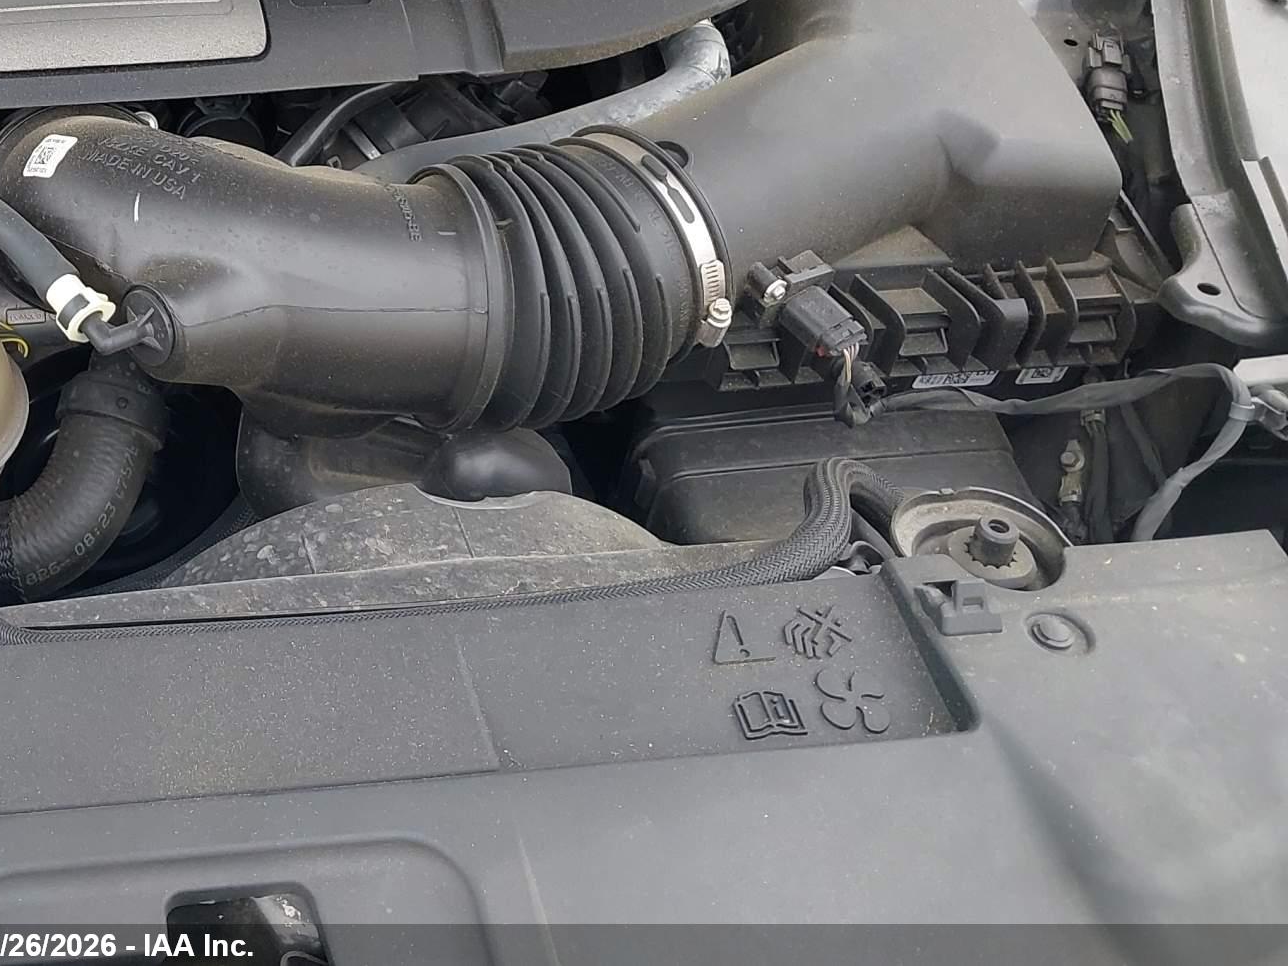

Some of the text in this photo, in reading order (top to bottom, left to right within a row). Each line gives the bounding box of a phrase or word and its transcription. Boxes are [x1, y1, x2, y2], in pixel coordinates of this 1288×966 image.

[80, 146, 132, 171] MADE
[131, 162, 153, 180] IN
[151, 171, 188, 200] USA
